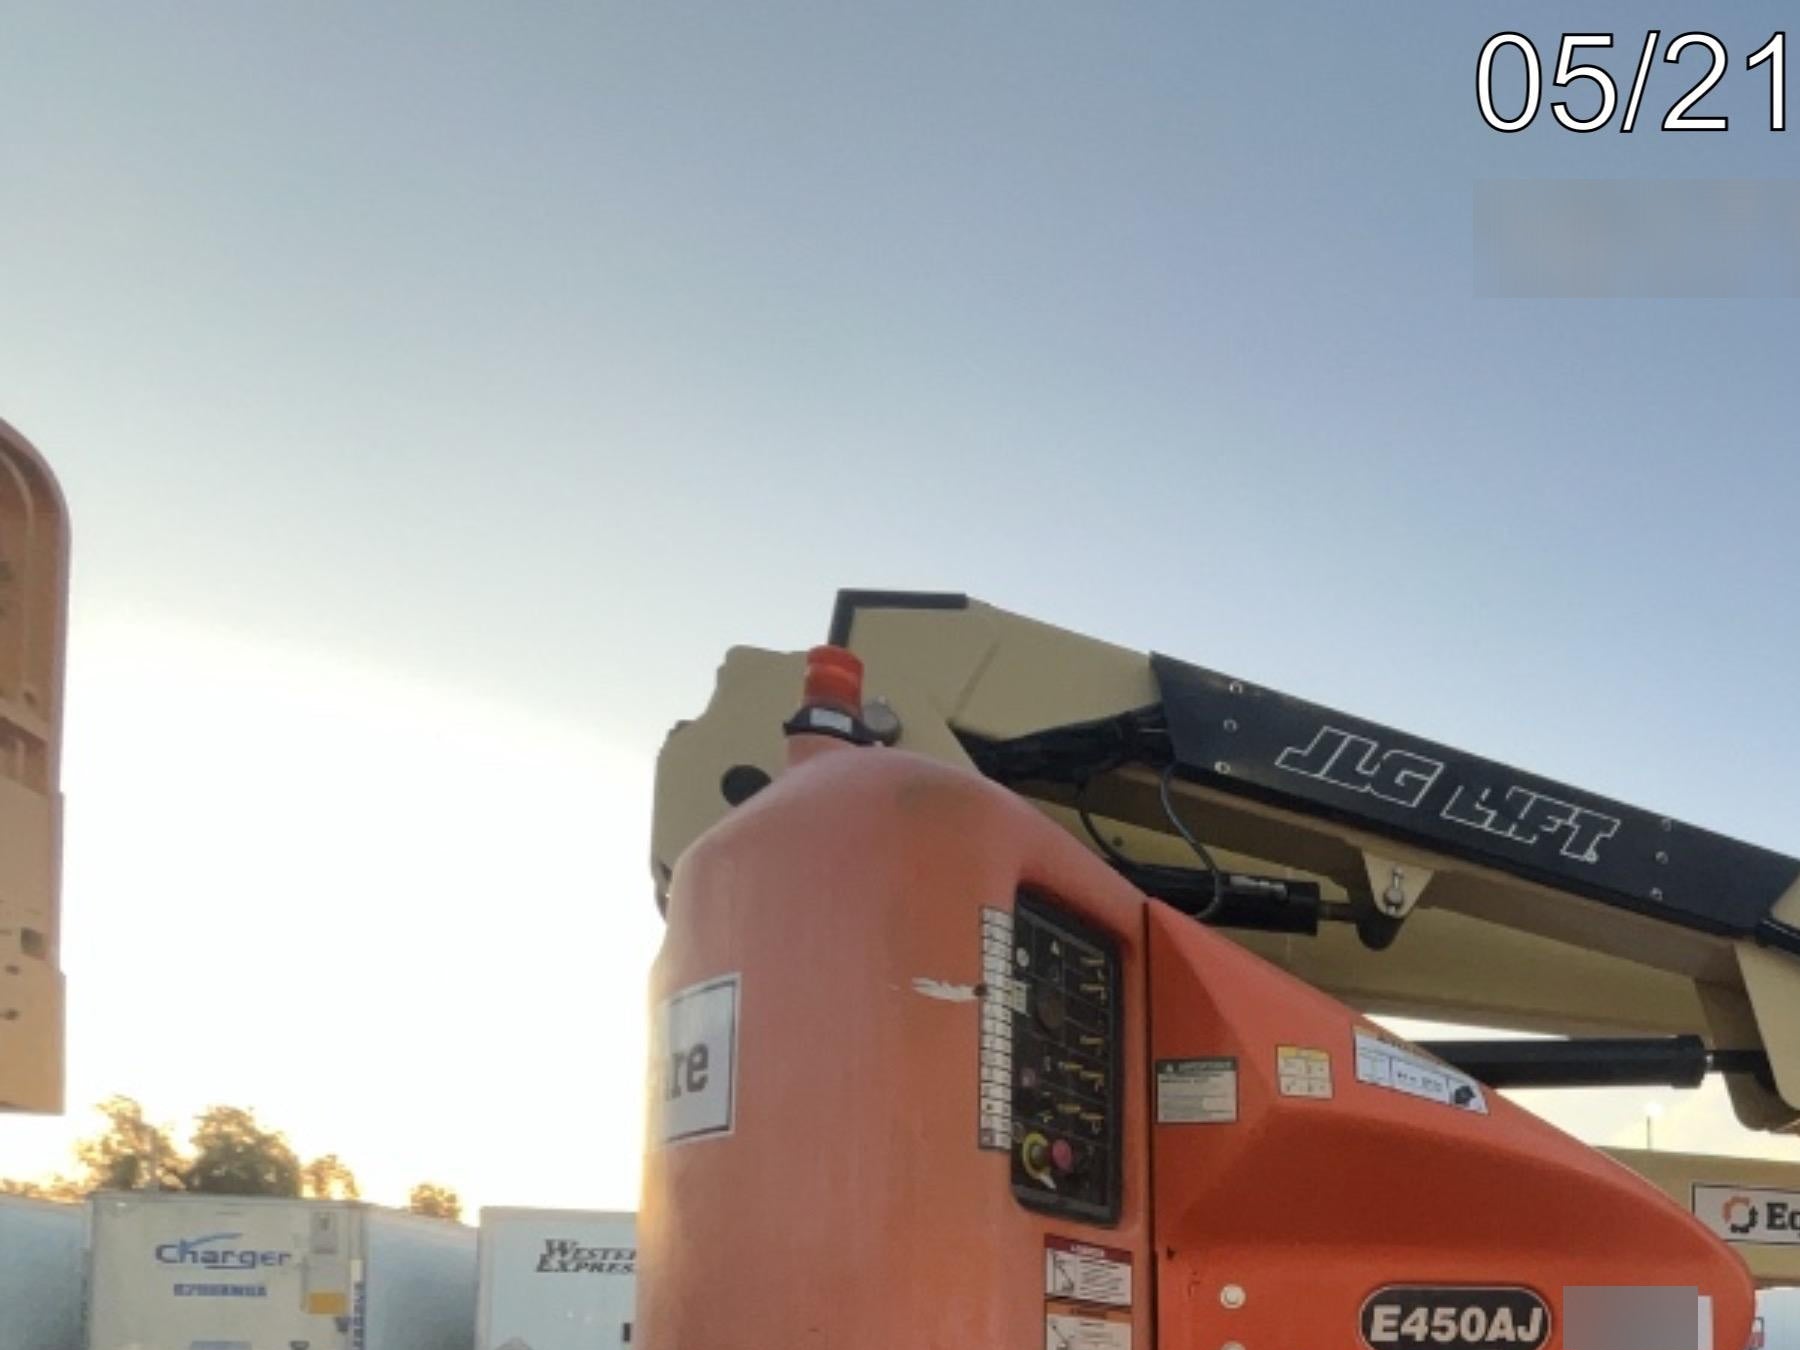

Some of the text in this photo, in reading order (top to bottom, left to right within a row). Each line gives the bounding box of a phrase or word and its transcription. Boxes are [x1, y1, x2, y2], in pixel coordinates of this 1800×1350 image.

[1275, 726, 1621, 864] JLG LIFT
[155, 1236, 292, 1270] Charger
[536, 1253, 635, 1273] EXPRES
[1370, 1304, 1543, 1343] E450AJ
